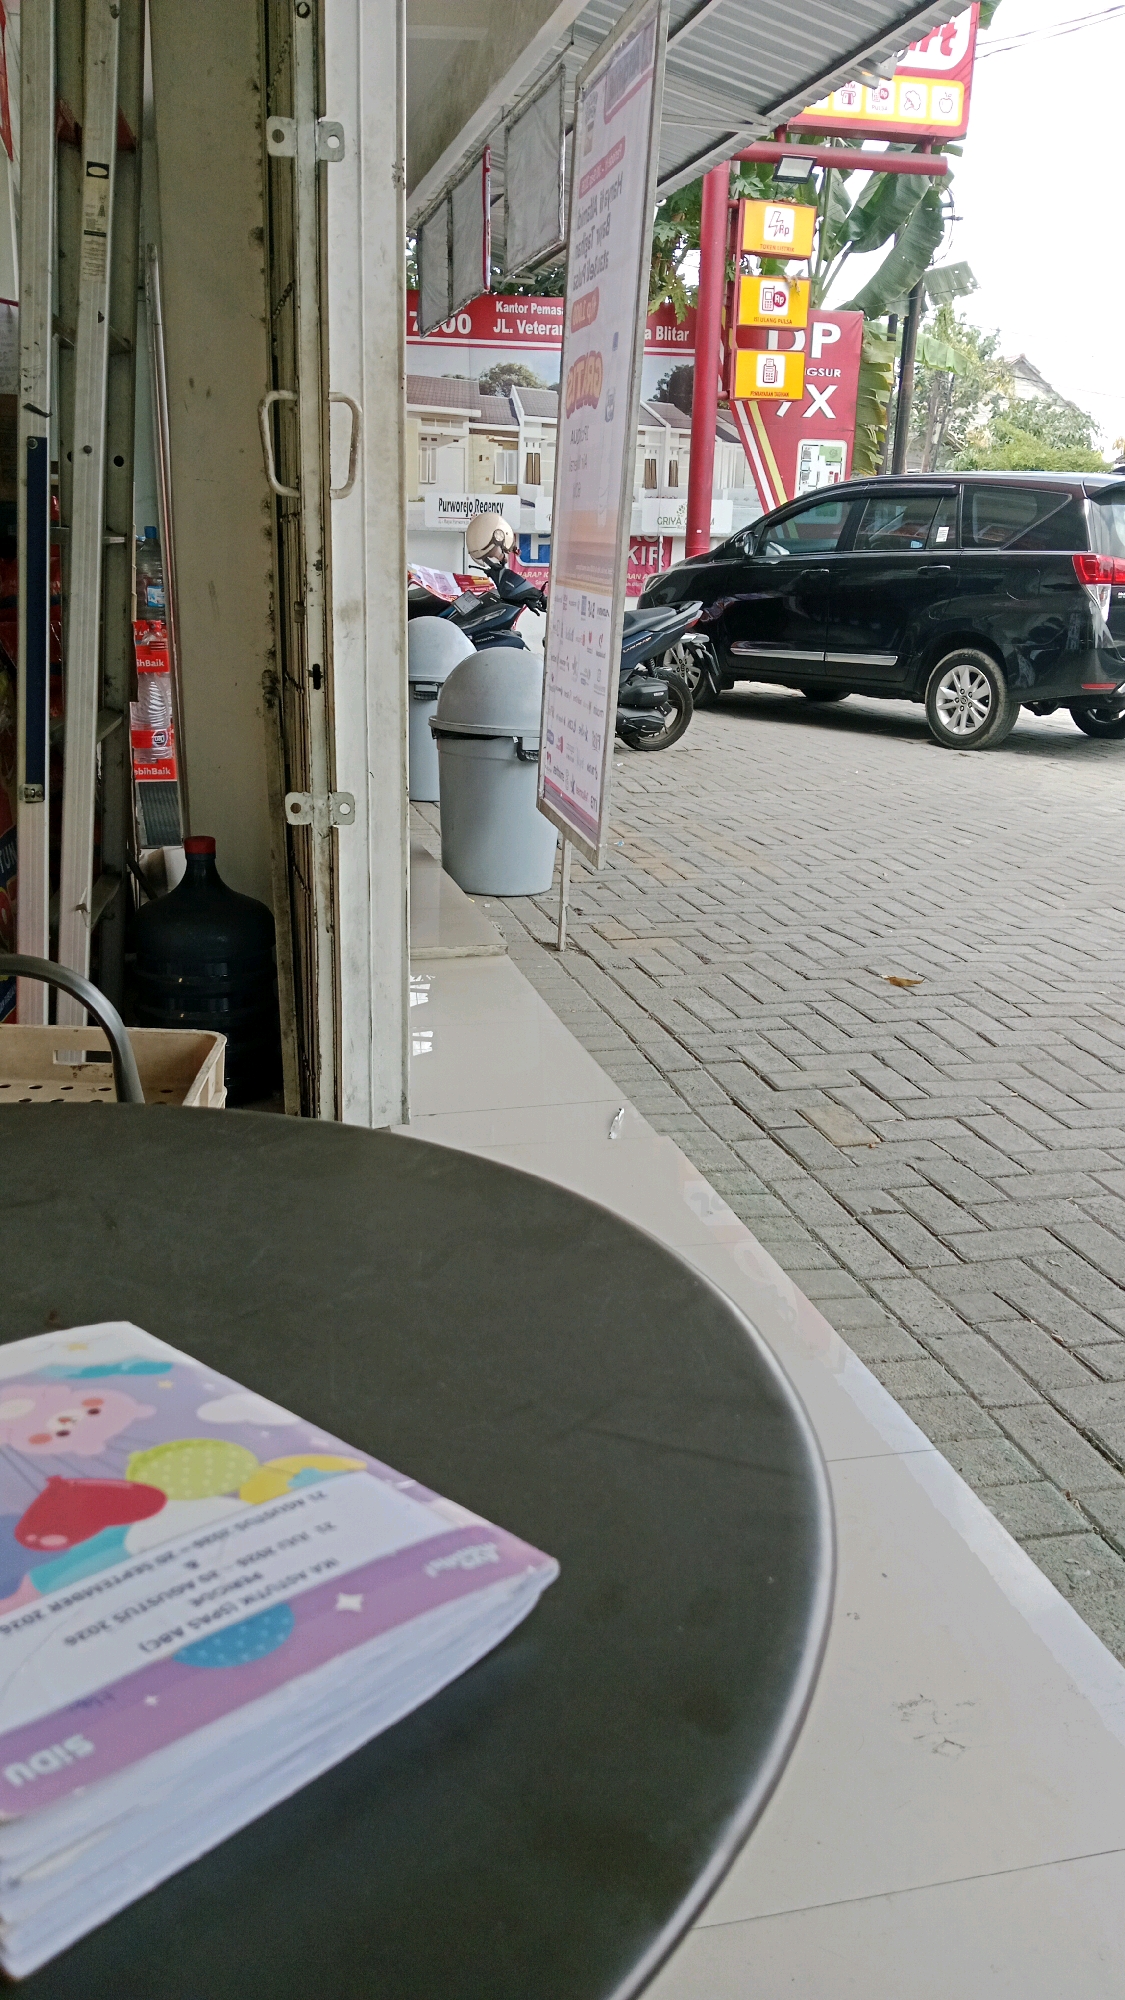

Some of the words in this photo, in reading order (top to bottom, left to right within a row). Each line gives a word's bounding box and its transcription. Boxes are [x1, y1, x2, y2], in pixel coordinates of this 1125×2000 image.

[496, 301, 529, 315] Kantor
[493, 318, 514, 334] JL.
[774, 318, 793, 326] PULSA
[656, 325, 689, 342] Blitar
[438, 497, 474, 518] Purworejo
[657, 516, 682, 527] GRIYA
[48, 1563, 155, 1615] SEPTEMBER
[111, 1579, 195, 1625] AGUSTUS
[0, 1608, 45, 1639] 2026
[62, 1619, 112, 1649] 2026
[138, 1626, 185, 1654] ABC)
